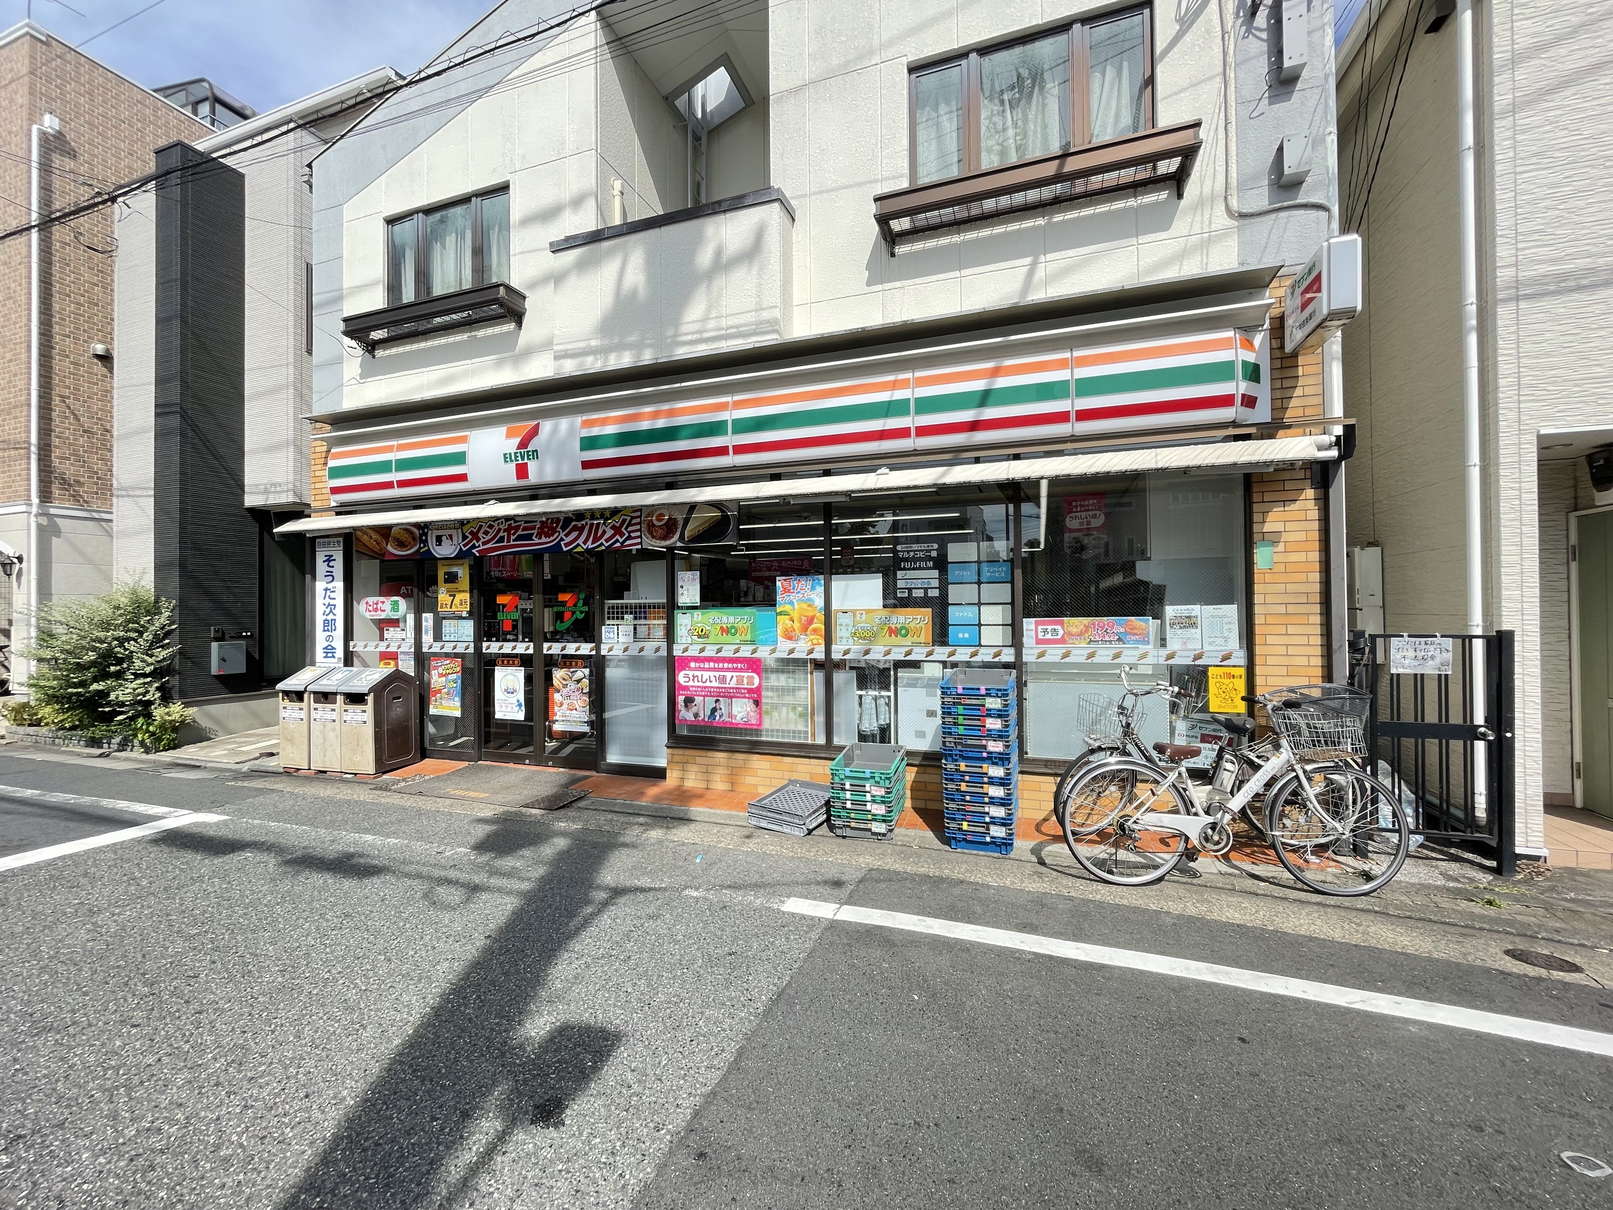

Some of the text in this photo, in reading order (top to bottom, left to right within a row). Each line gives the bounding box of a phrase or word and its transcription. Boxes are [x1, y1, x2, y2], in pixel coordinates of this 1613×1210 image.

[322, 554, 337, 659] そうだ次郎の会
[365, 599, 400, 613] たばこ 酒
[1040, 627, 1059, 637] 予告
